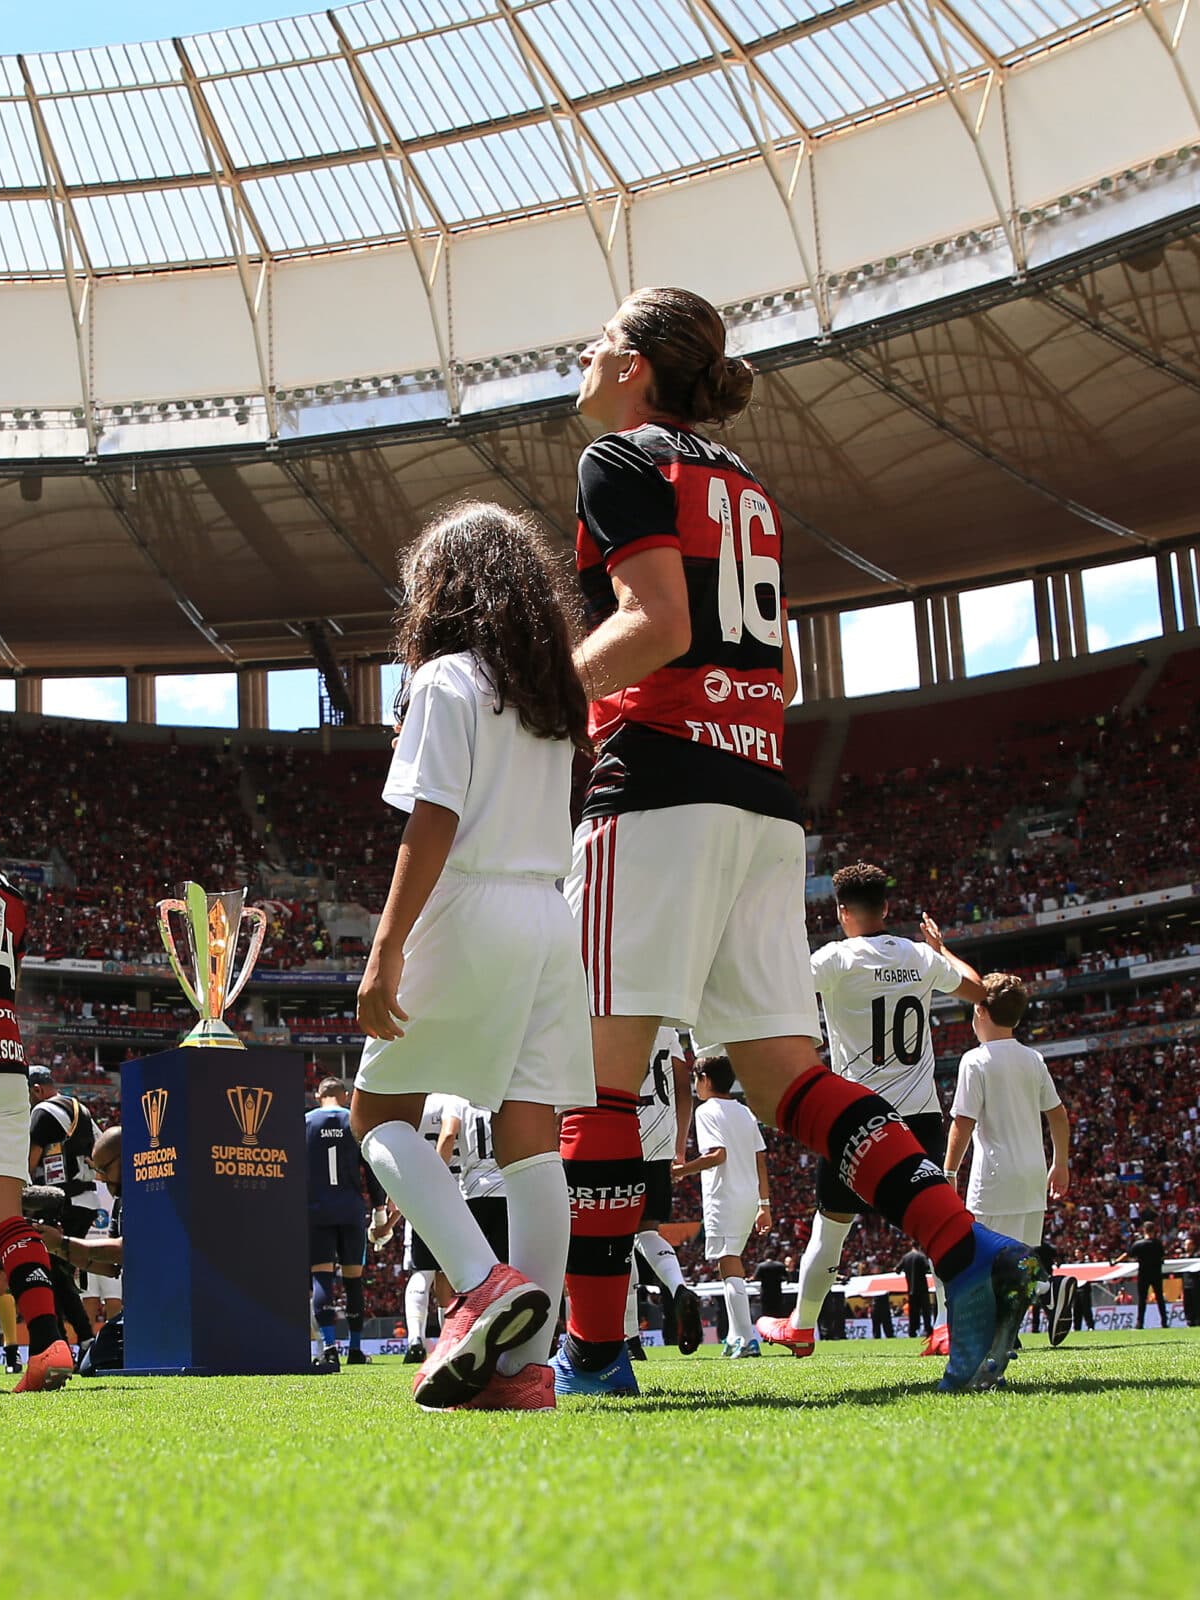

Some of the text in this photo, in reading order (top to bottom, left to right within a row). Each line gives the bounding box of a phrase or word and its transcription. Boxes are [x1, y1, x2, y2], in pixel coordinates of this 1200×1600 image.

[752, 500, 767, 513] TIM
[707, 476, 783, 648] 16
[733, 681, 784, 704] TOTA
[685, 720, 768, 761] FILIPE
[874, 968, 922, 983] M.GABRIEL
[871, 995, 925, 1067] 10
[320, 1128, 344, 1138] SANTOS
[133, 1146, 177, 1167] SUPERCOPA
[211, 1145, 288, 1163] SUPERCOPA
[135, 1163, 175, 1182] DO BRASIL
[215, 1161, 285, 1178] DO BRASIL
[327, 1145, 338, 1185] 1
[1094, 1313, 1134, 1326] PORTS
[380, 1345, 409, 1355] SPOR
